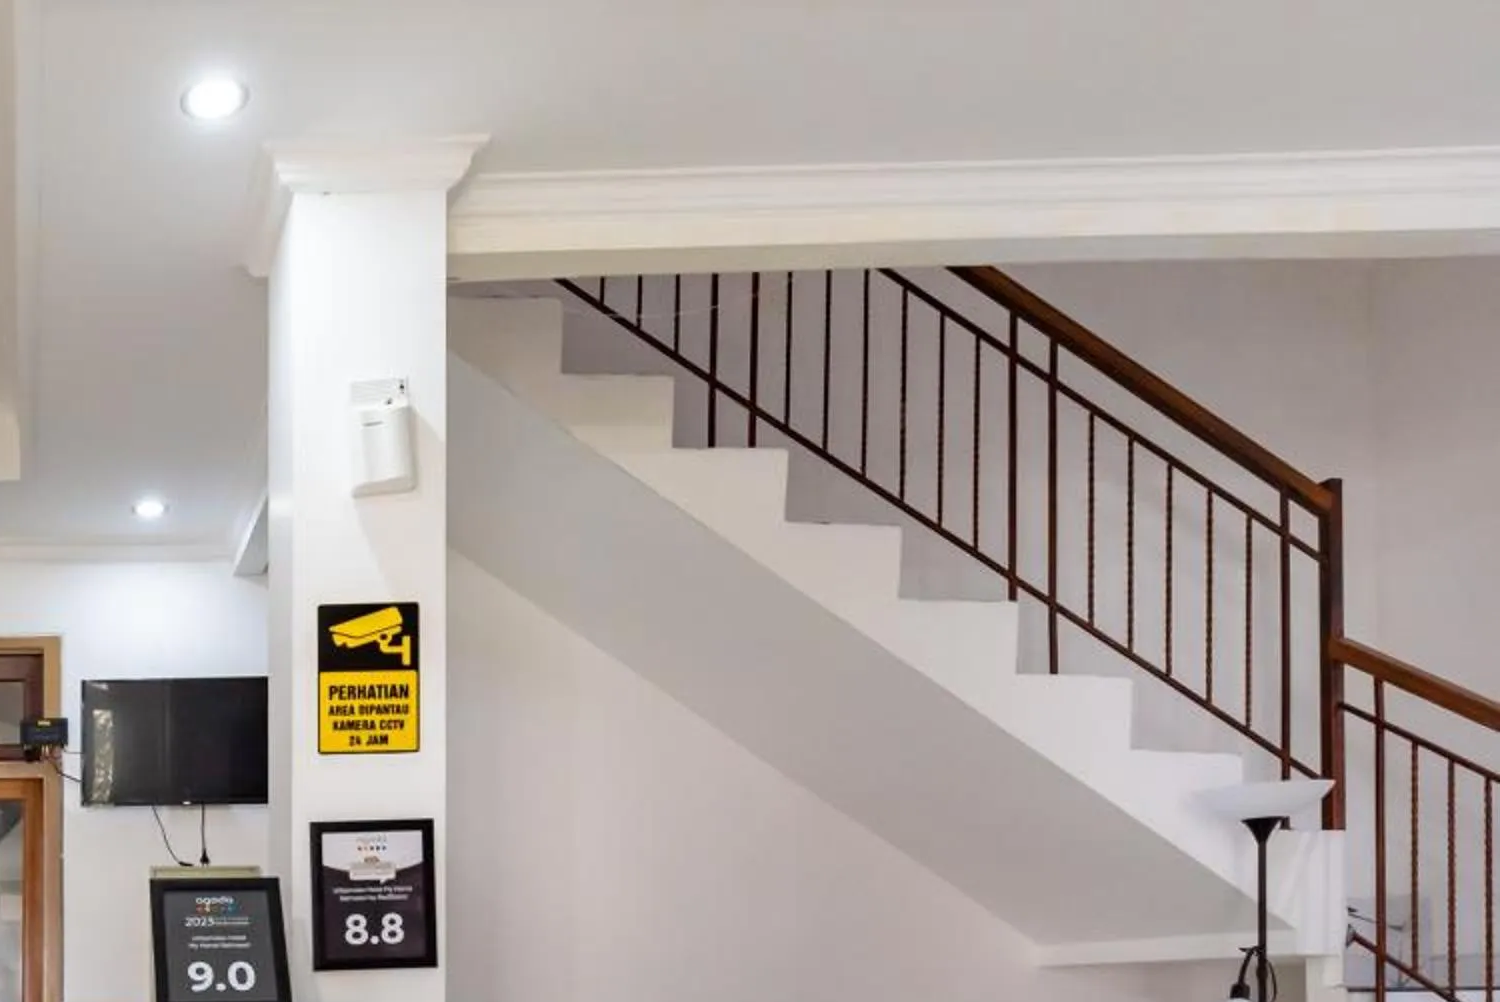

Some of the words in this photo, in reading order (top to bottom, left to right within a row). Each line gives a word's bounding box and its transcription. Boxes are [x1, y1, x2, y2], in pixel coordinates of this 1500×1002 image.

[328, 684, 409, 700] PERHATIAN
[328, 705, 355, 716] AREA
[358, 704, 409, 716] DIPANTAU
[332, 719, 376, 731] KAMERA
[379, 719, 405, 730] CCTV
[366, 735, 389, 745] JAM
[344, 912, 405, 945] 8.8
[187, 960, 256, 992] 9.0
